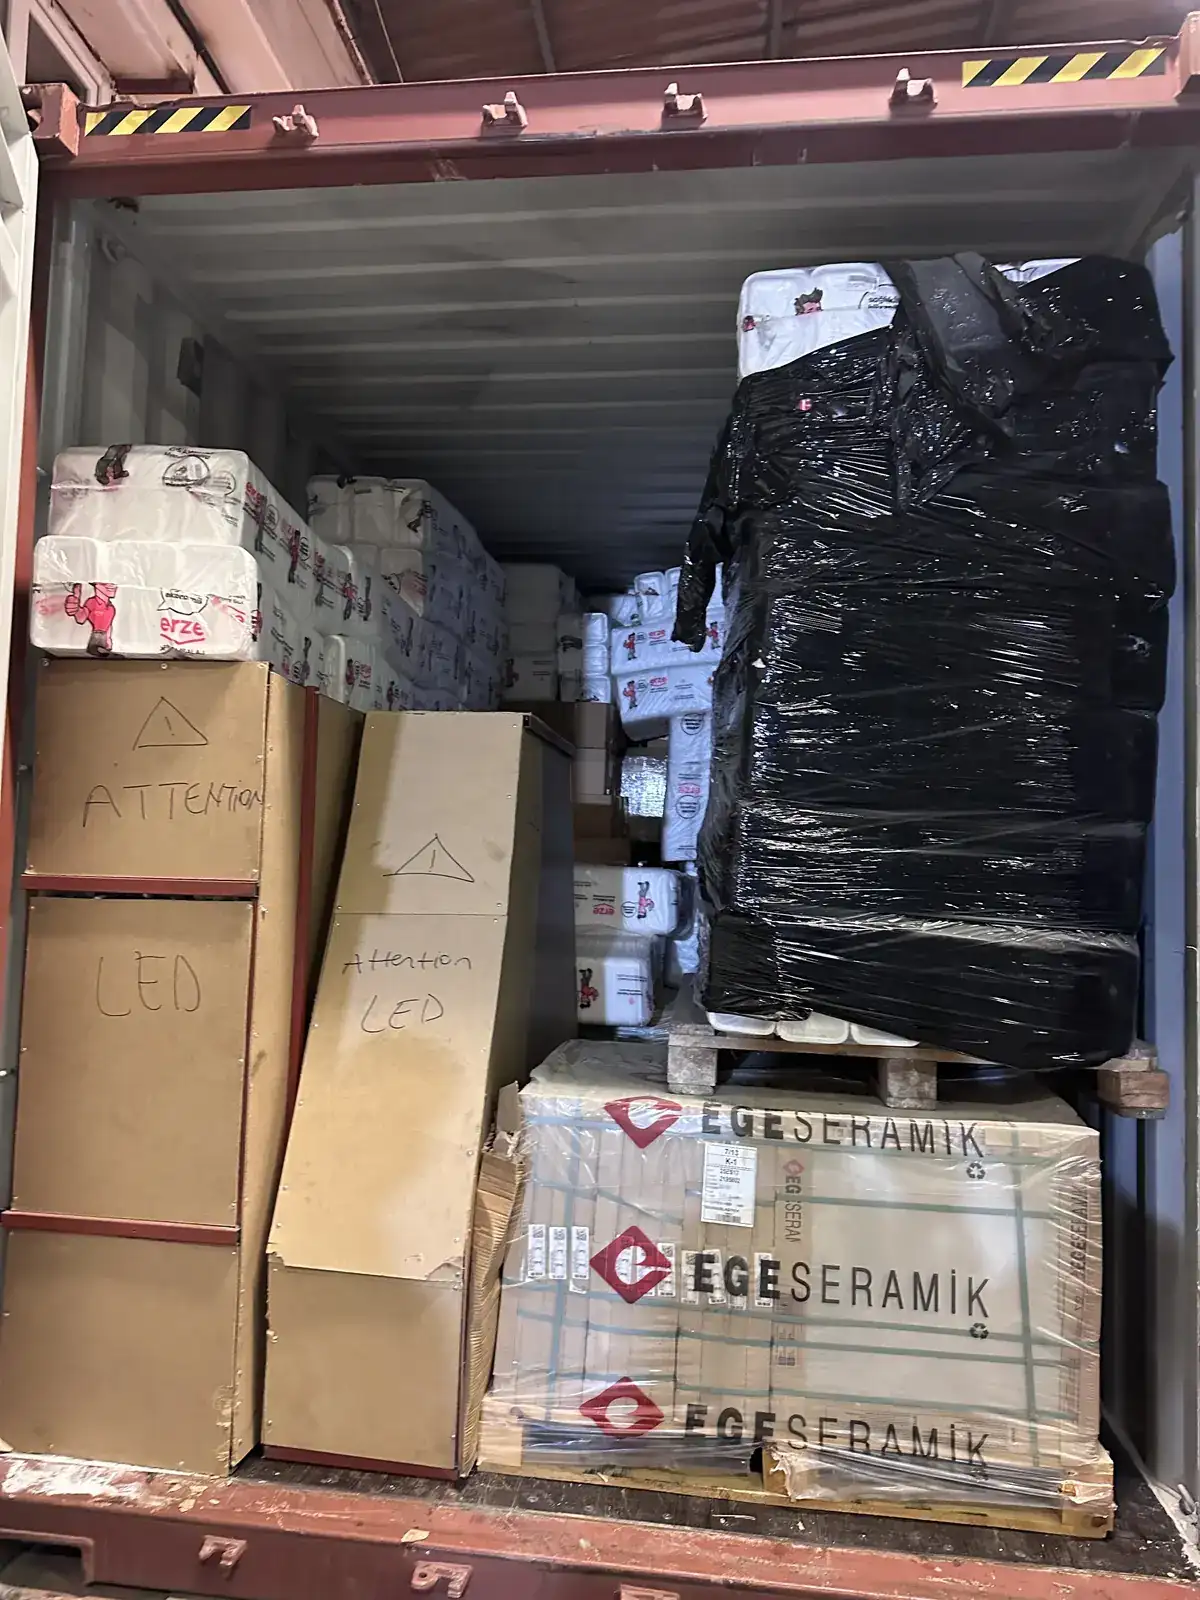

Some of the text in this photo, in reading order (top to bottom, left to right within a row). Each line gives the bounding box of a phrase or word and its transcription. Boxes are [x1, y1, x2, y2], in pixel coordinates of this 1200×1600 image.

[160, 616, 205, 636] erze
[342, 949, 472, 975] Attention
[97, 951, 200, 1017] LED
[361, 993, 444, 1033] LED
[692, 1252, 990, 1319] EGESERAMİK
